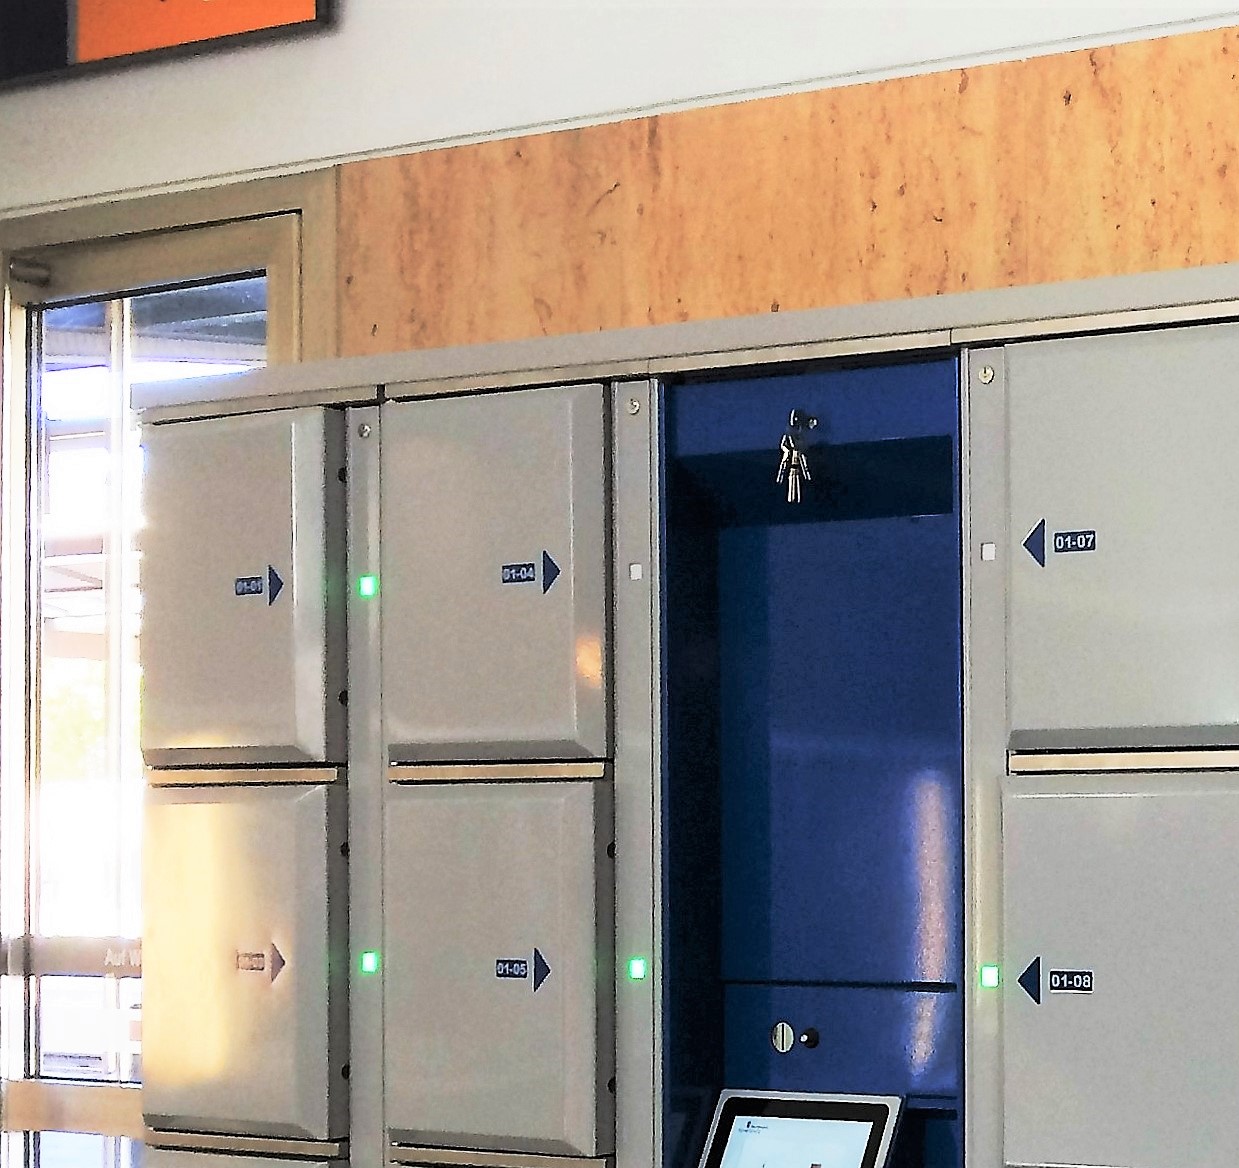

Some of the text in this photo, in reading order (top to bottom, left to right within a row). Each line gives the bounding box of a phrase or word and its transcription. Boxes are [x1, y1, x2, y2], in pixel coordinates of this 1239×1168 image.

[1055, 534, 1094, 549] 01-07
[503, 566, 533, 580] 01-04
[497, 962, 526, 975] 01-05
[1051, 973, 1091, 988] 01-08
